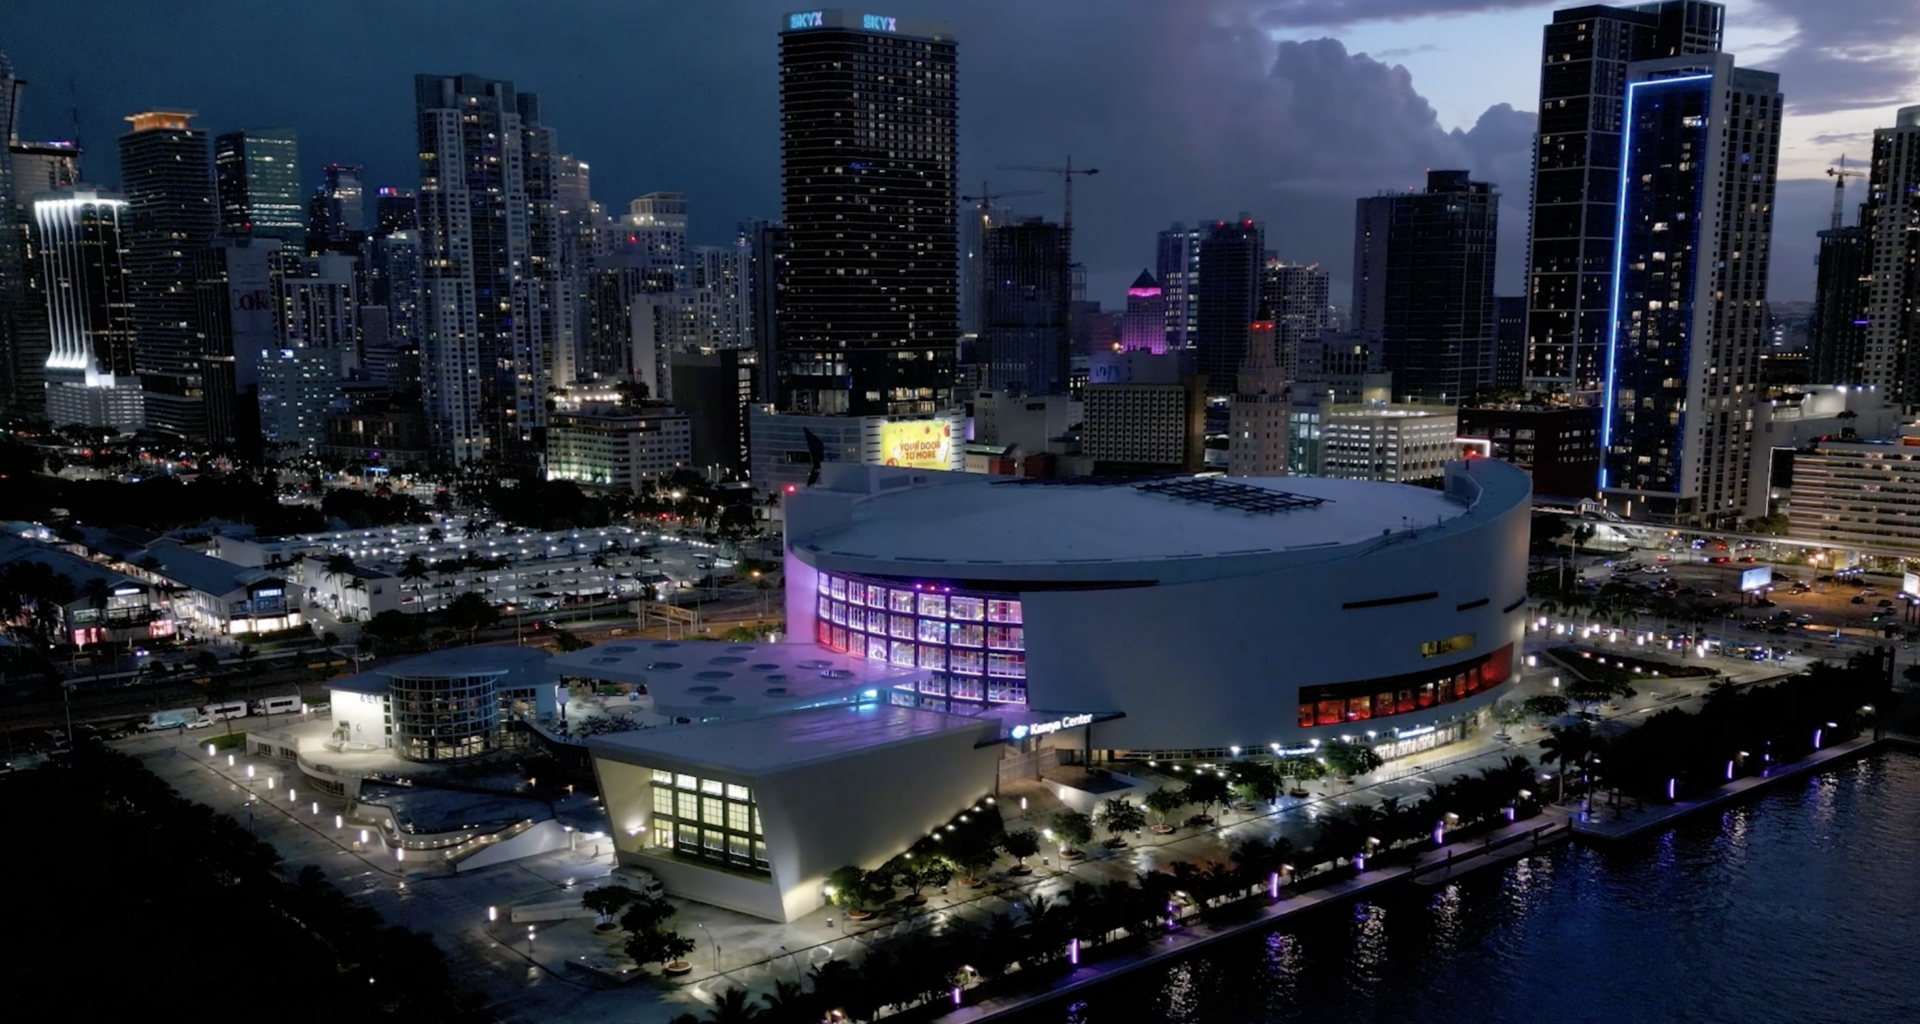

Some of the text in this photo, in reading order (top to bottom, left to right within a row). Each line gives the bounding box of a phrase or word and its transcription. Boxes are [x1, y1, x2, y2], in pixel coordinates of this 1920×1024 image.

[790, 11, 823, 29] SKYX
[863, 14, 896, 31] SKYX
[900, 441, 941, 452] YOUR DOOR
[905, 450, 936, 460] TO MORE
[1030, 713, 1093, 735] Kaseya Center
